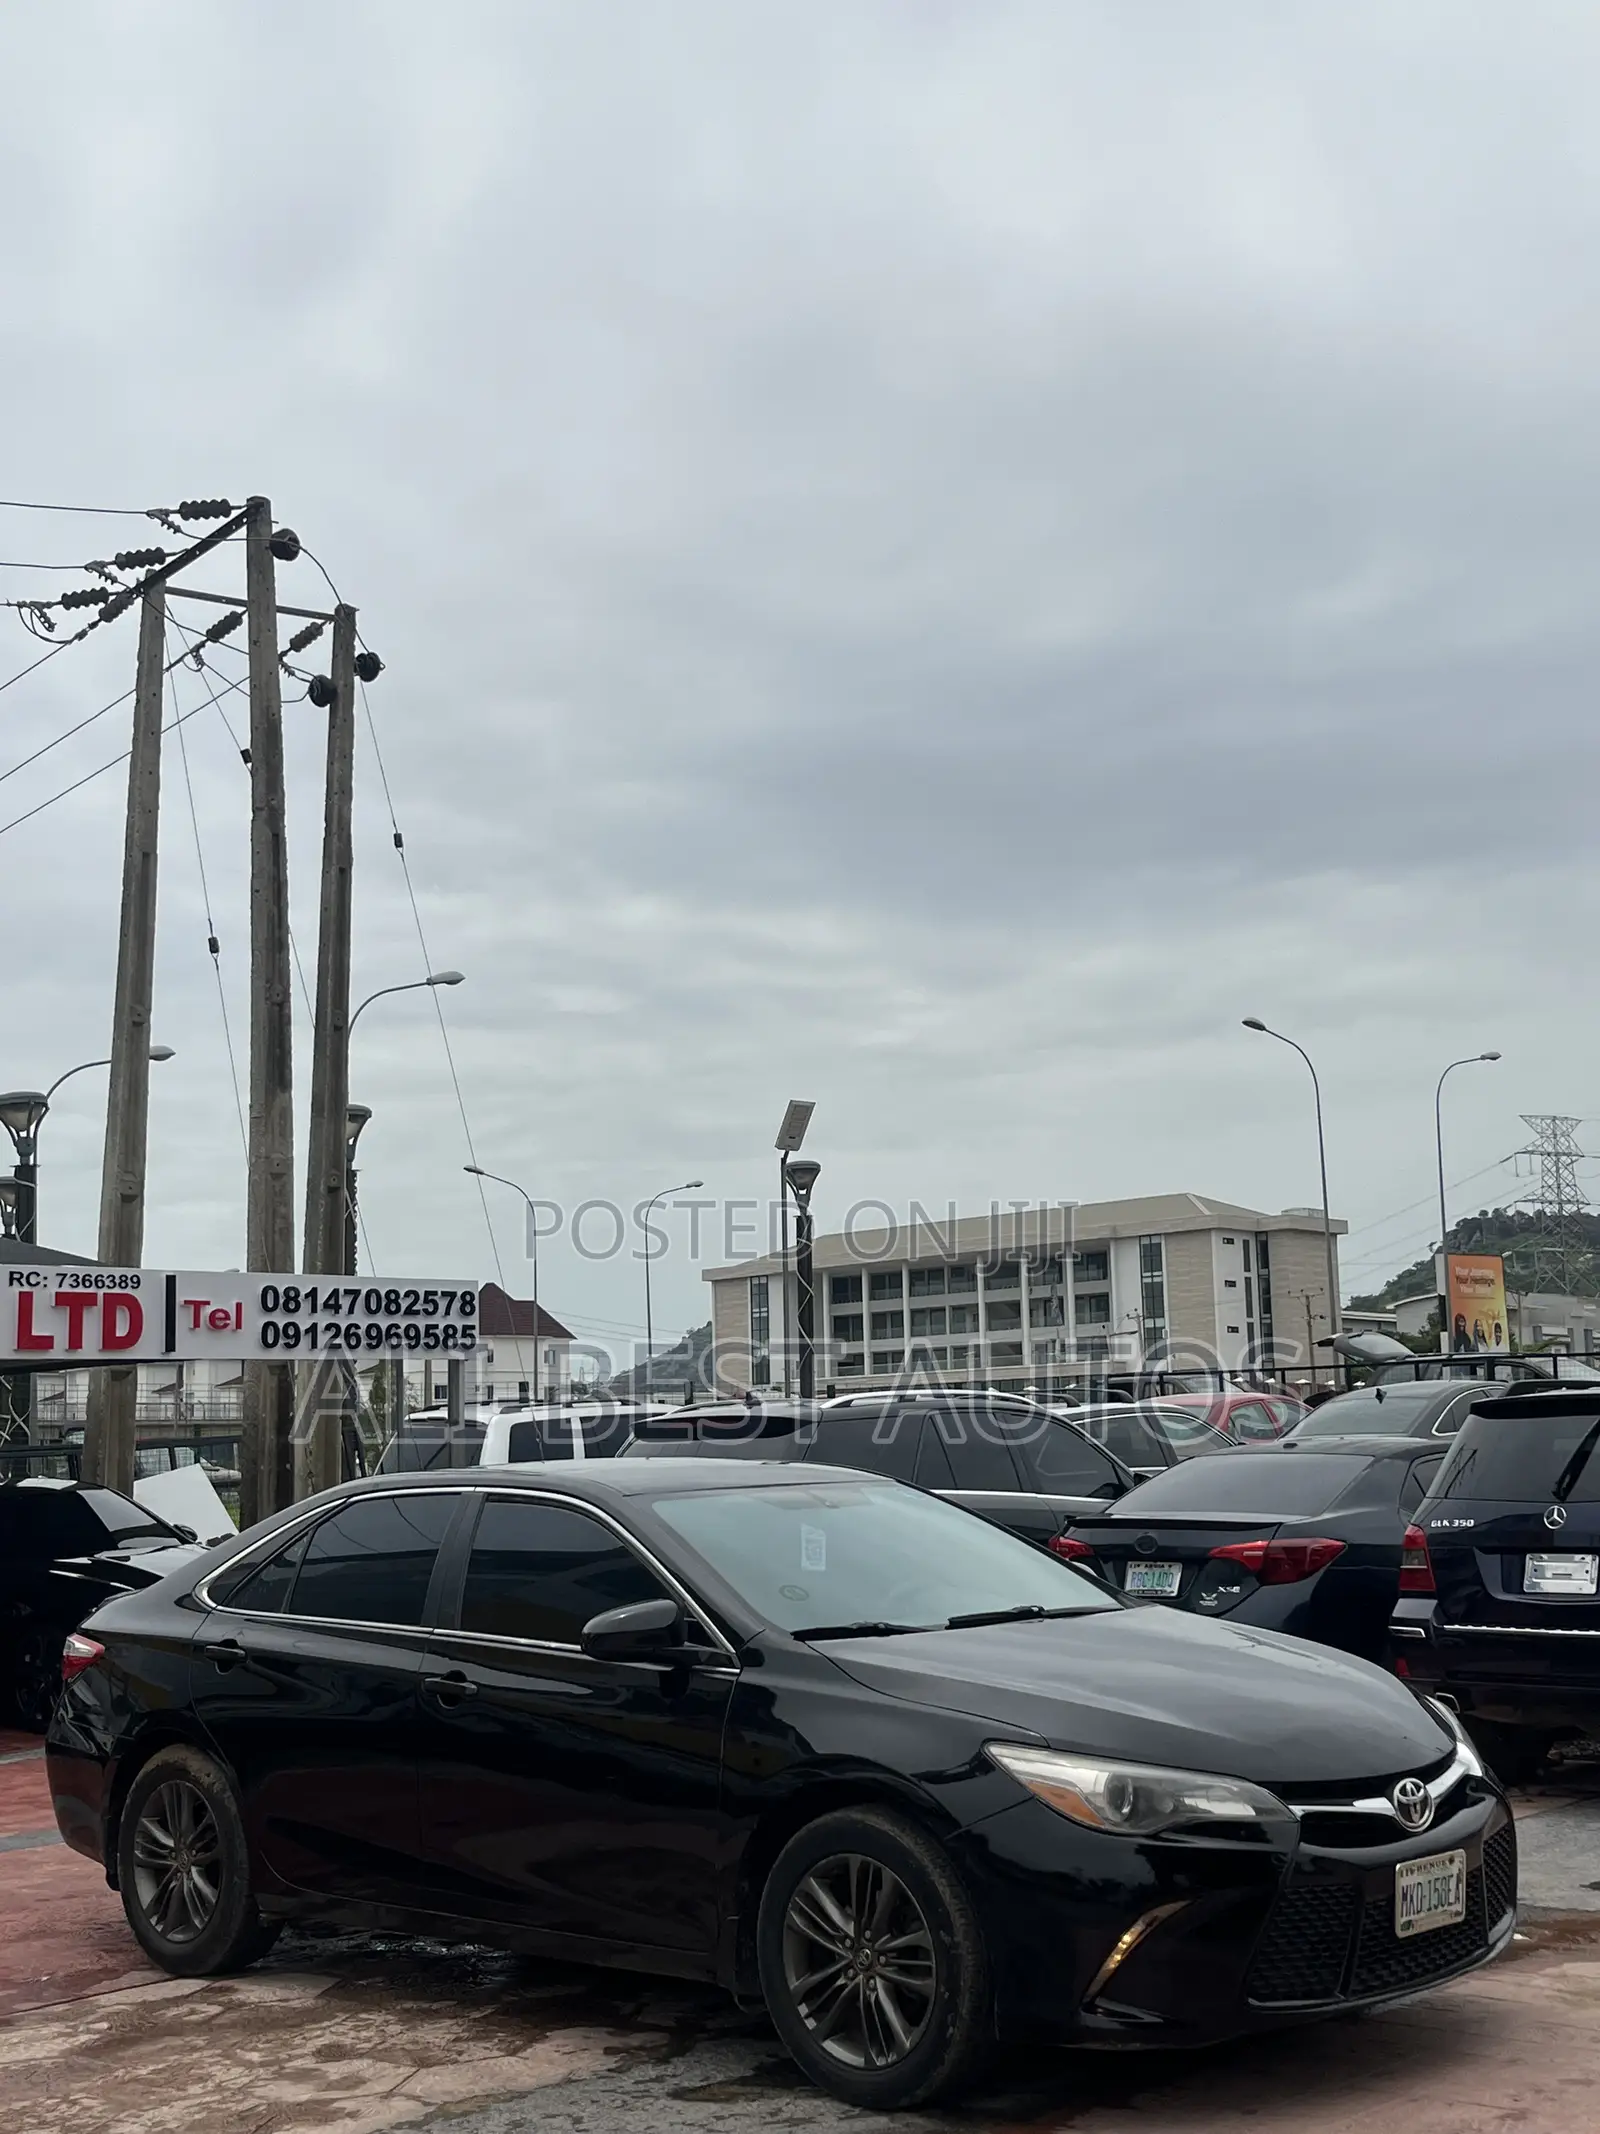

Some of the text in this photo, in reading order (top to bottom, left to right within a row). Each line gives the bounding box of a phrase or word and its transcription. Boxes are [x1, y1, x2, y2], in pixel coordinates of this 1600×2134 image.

[8, 1270, 142, 1290] RC: 7366389
[182, 1299, 244, 1331] Tel
[260, 1284, 477, 1317] 08147082578
[16, 1290, 144, 1351] LTD
[260, 1320, 477, 1350] 09126969585
[1430, 1519, 1475, 1528] GLK 350
